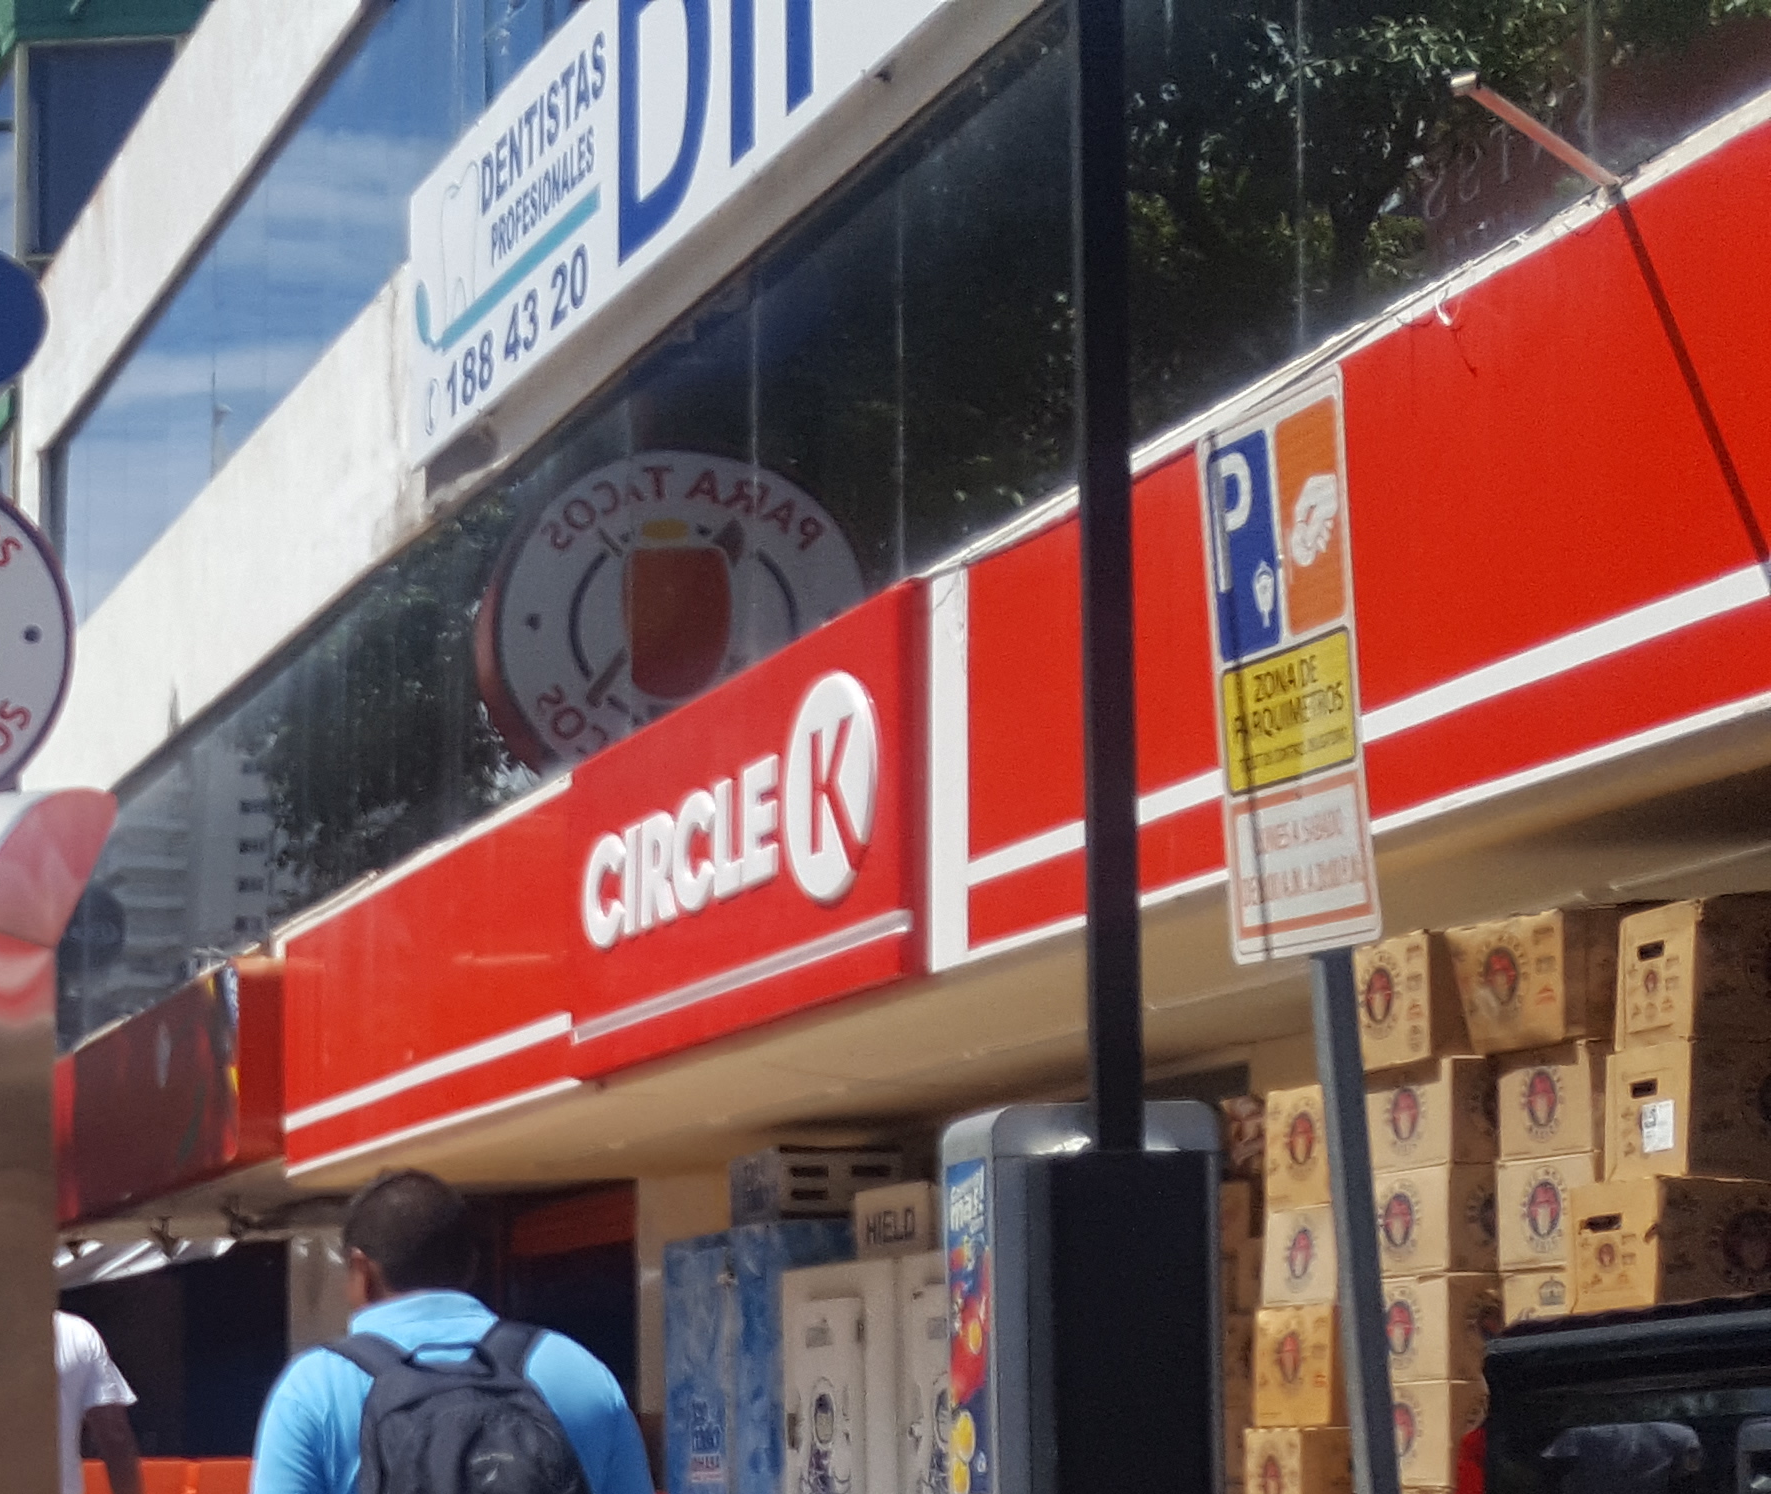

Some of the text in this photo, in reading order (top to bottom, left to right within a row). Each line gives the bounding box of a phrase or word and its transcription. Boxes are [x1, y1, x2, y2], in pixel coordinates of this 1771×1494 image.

[480, 31, 607, 213] DENTISTAS
[489, 125, 596, 267] PROFESIONALES
[446, 243, 590, 418] 188 43 20
[1211, 450, 1252, 593] P
[1253, 654, 1319, 702] ZONA DE
[581, 752, 780, 951] CIRCLE
